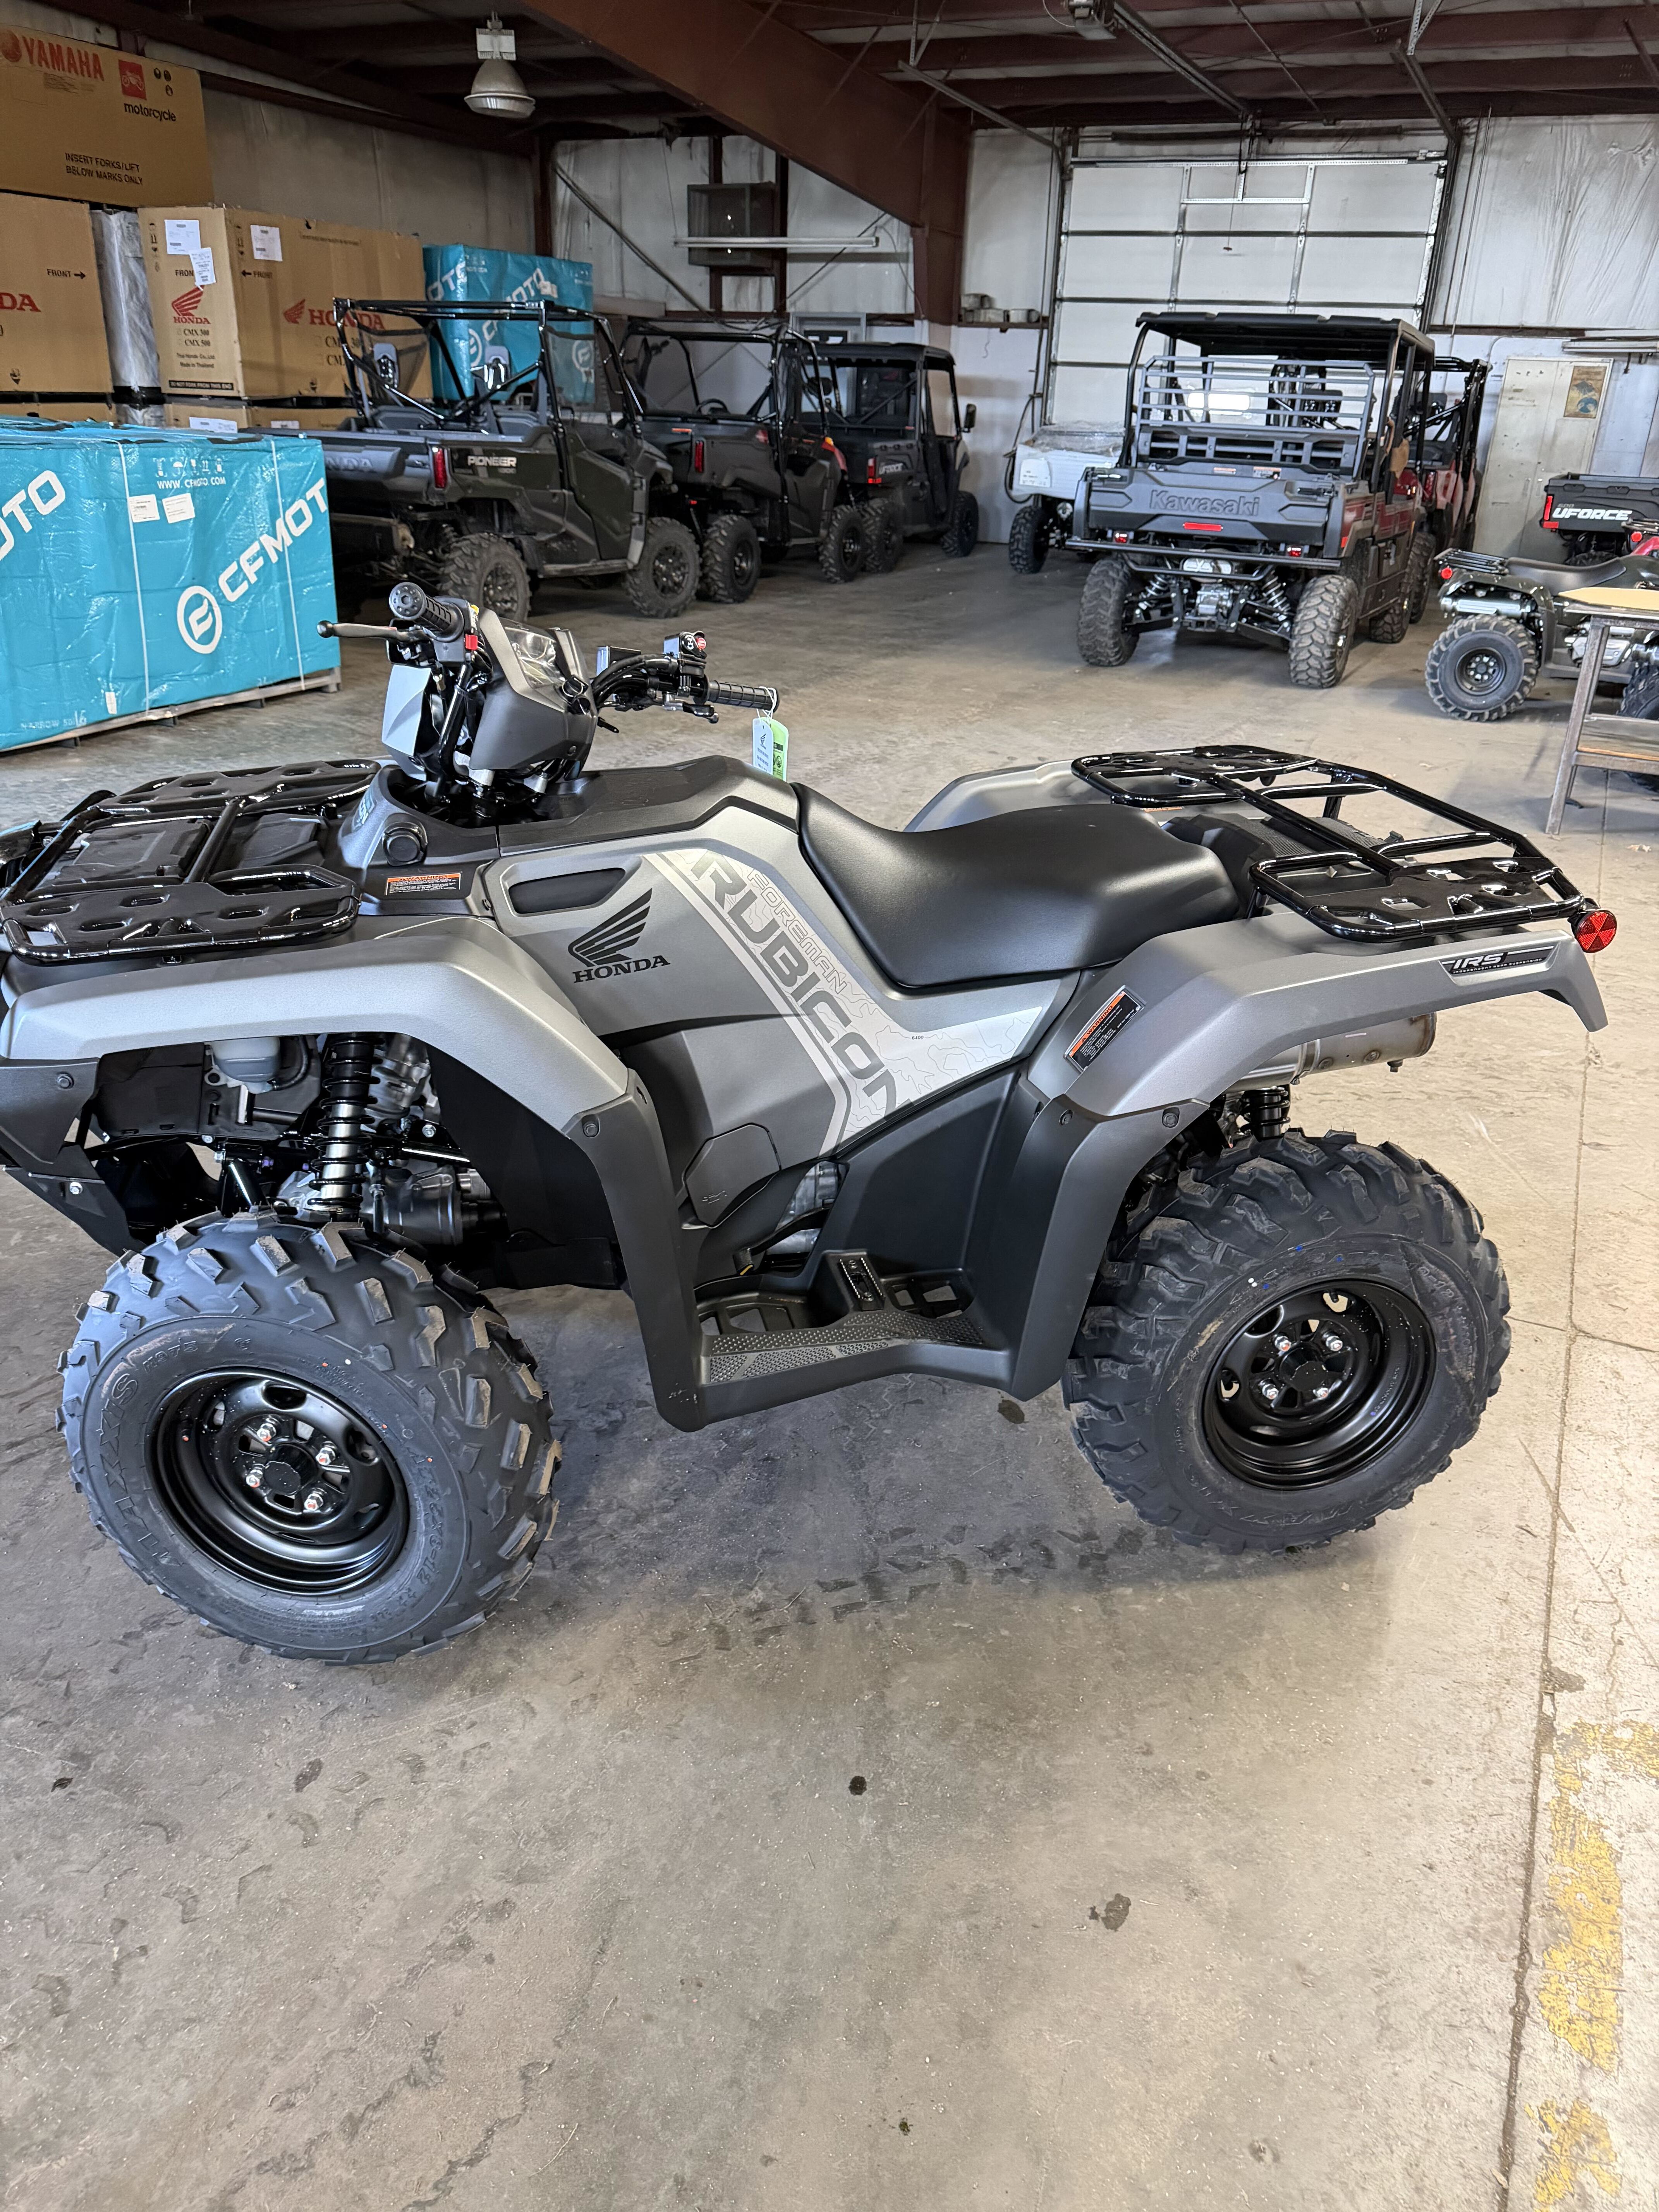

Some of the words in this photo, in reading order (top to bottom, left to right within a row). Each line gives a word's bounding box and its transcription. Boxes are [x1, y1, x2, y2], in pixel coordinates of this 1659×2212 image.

[22, 36, 105, 81] YAMAHA
[124, 103, 176, 122] motorcycle
[65, 153, 93, 165] INSERT
[95, 158, 139, 172] FORKS/LIFT
[66, 165, 93, 177] BELOW
[96, 172, 122, 182] MARKS
[124, 175, 143, 185] ONLY
[47, 269, 71, 277] FRONT
[467, 455, 517, 467] PIONEER
[210, 477, 226, 485] COM
[1150, 489, 1260, 516] Kawasaki
[1552, 508, 1633, 520] UFORCE
[747, 869, 847, 994] FOREMAN
[572, 955, 671, 983] HONDA
[1453, 953, 1504, 969] IRS
[1453, 966, 1491, 974] INDEPENDENT
[690, 849, 914, 1122] RUBICON
[1087, 1005, 1113, 1036] WARNING
